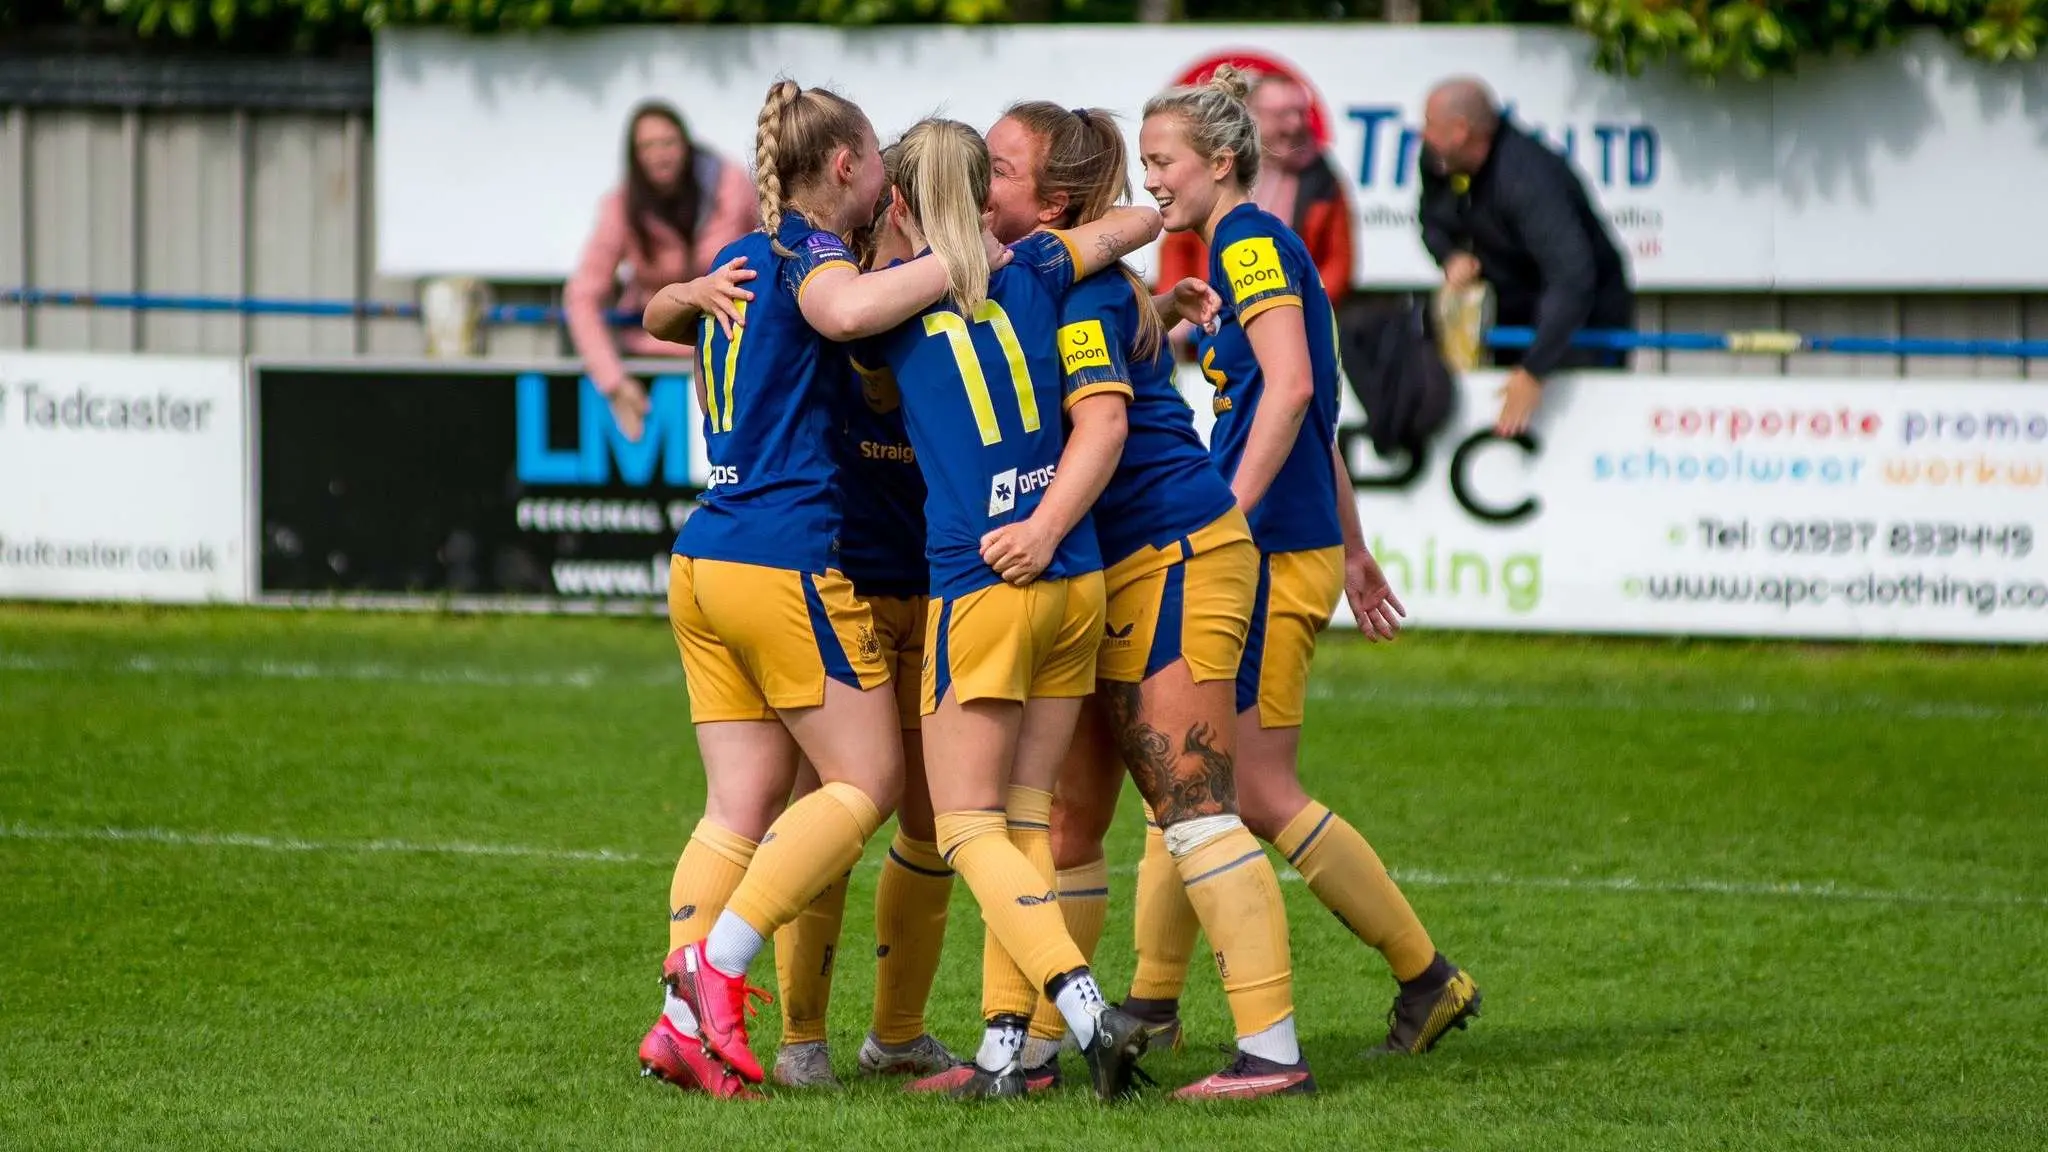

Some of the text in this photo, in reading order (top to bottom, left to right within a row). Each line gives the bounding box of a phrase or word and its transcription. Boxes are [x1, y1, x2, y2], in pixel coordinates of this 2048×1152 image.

[1234, 267, 1280, 293] noon
[922, 299, 1041, 447] 11
[1066, 346, 1105, 366] noon
[22, 382, 212, 431] Tadcaster
[1651, 406, 2048, 445] corporate promo
[515, 371, 712, 489] LM
[1593, 448, 2048, 487] schoolwear workw
[1770, 520, 1877, 552] 01937
[1648, 571, 2048, 616] www.apc-clothing.co
